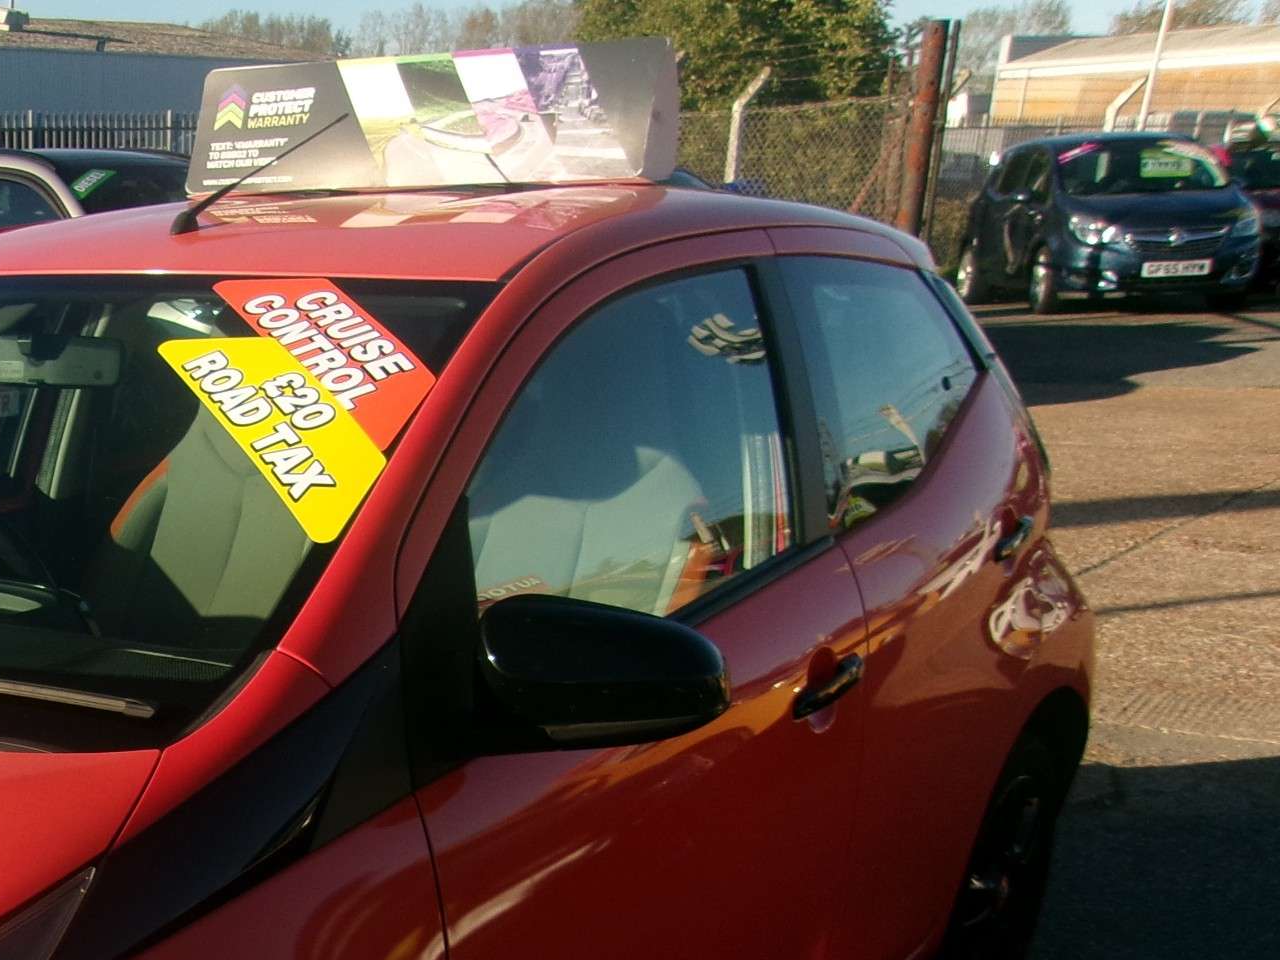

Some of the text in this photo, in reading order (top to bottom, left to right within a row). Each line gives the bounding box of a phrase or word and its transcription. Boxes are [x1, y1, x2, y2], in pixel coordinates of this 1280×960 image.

[247, 113, 310, 129] WARRANTY
[249, 99, 314, 118] PROTECT
[73, 170, 107, 193] DIESEL
[243, 293, 378, 411] CONTROL
[295, 290, 417, 381] CRUISE
[181, 350, 337, 503] ROAD TAX
[260, 371, 337, 430] £20
